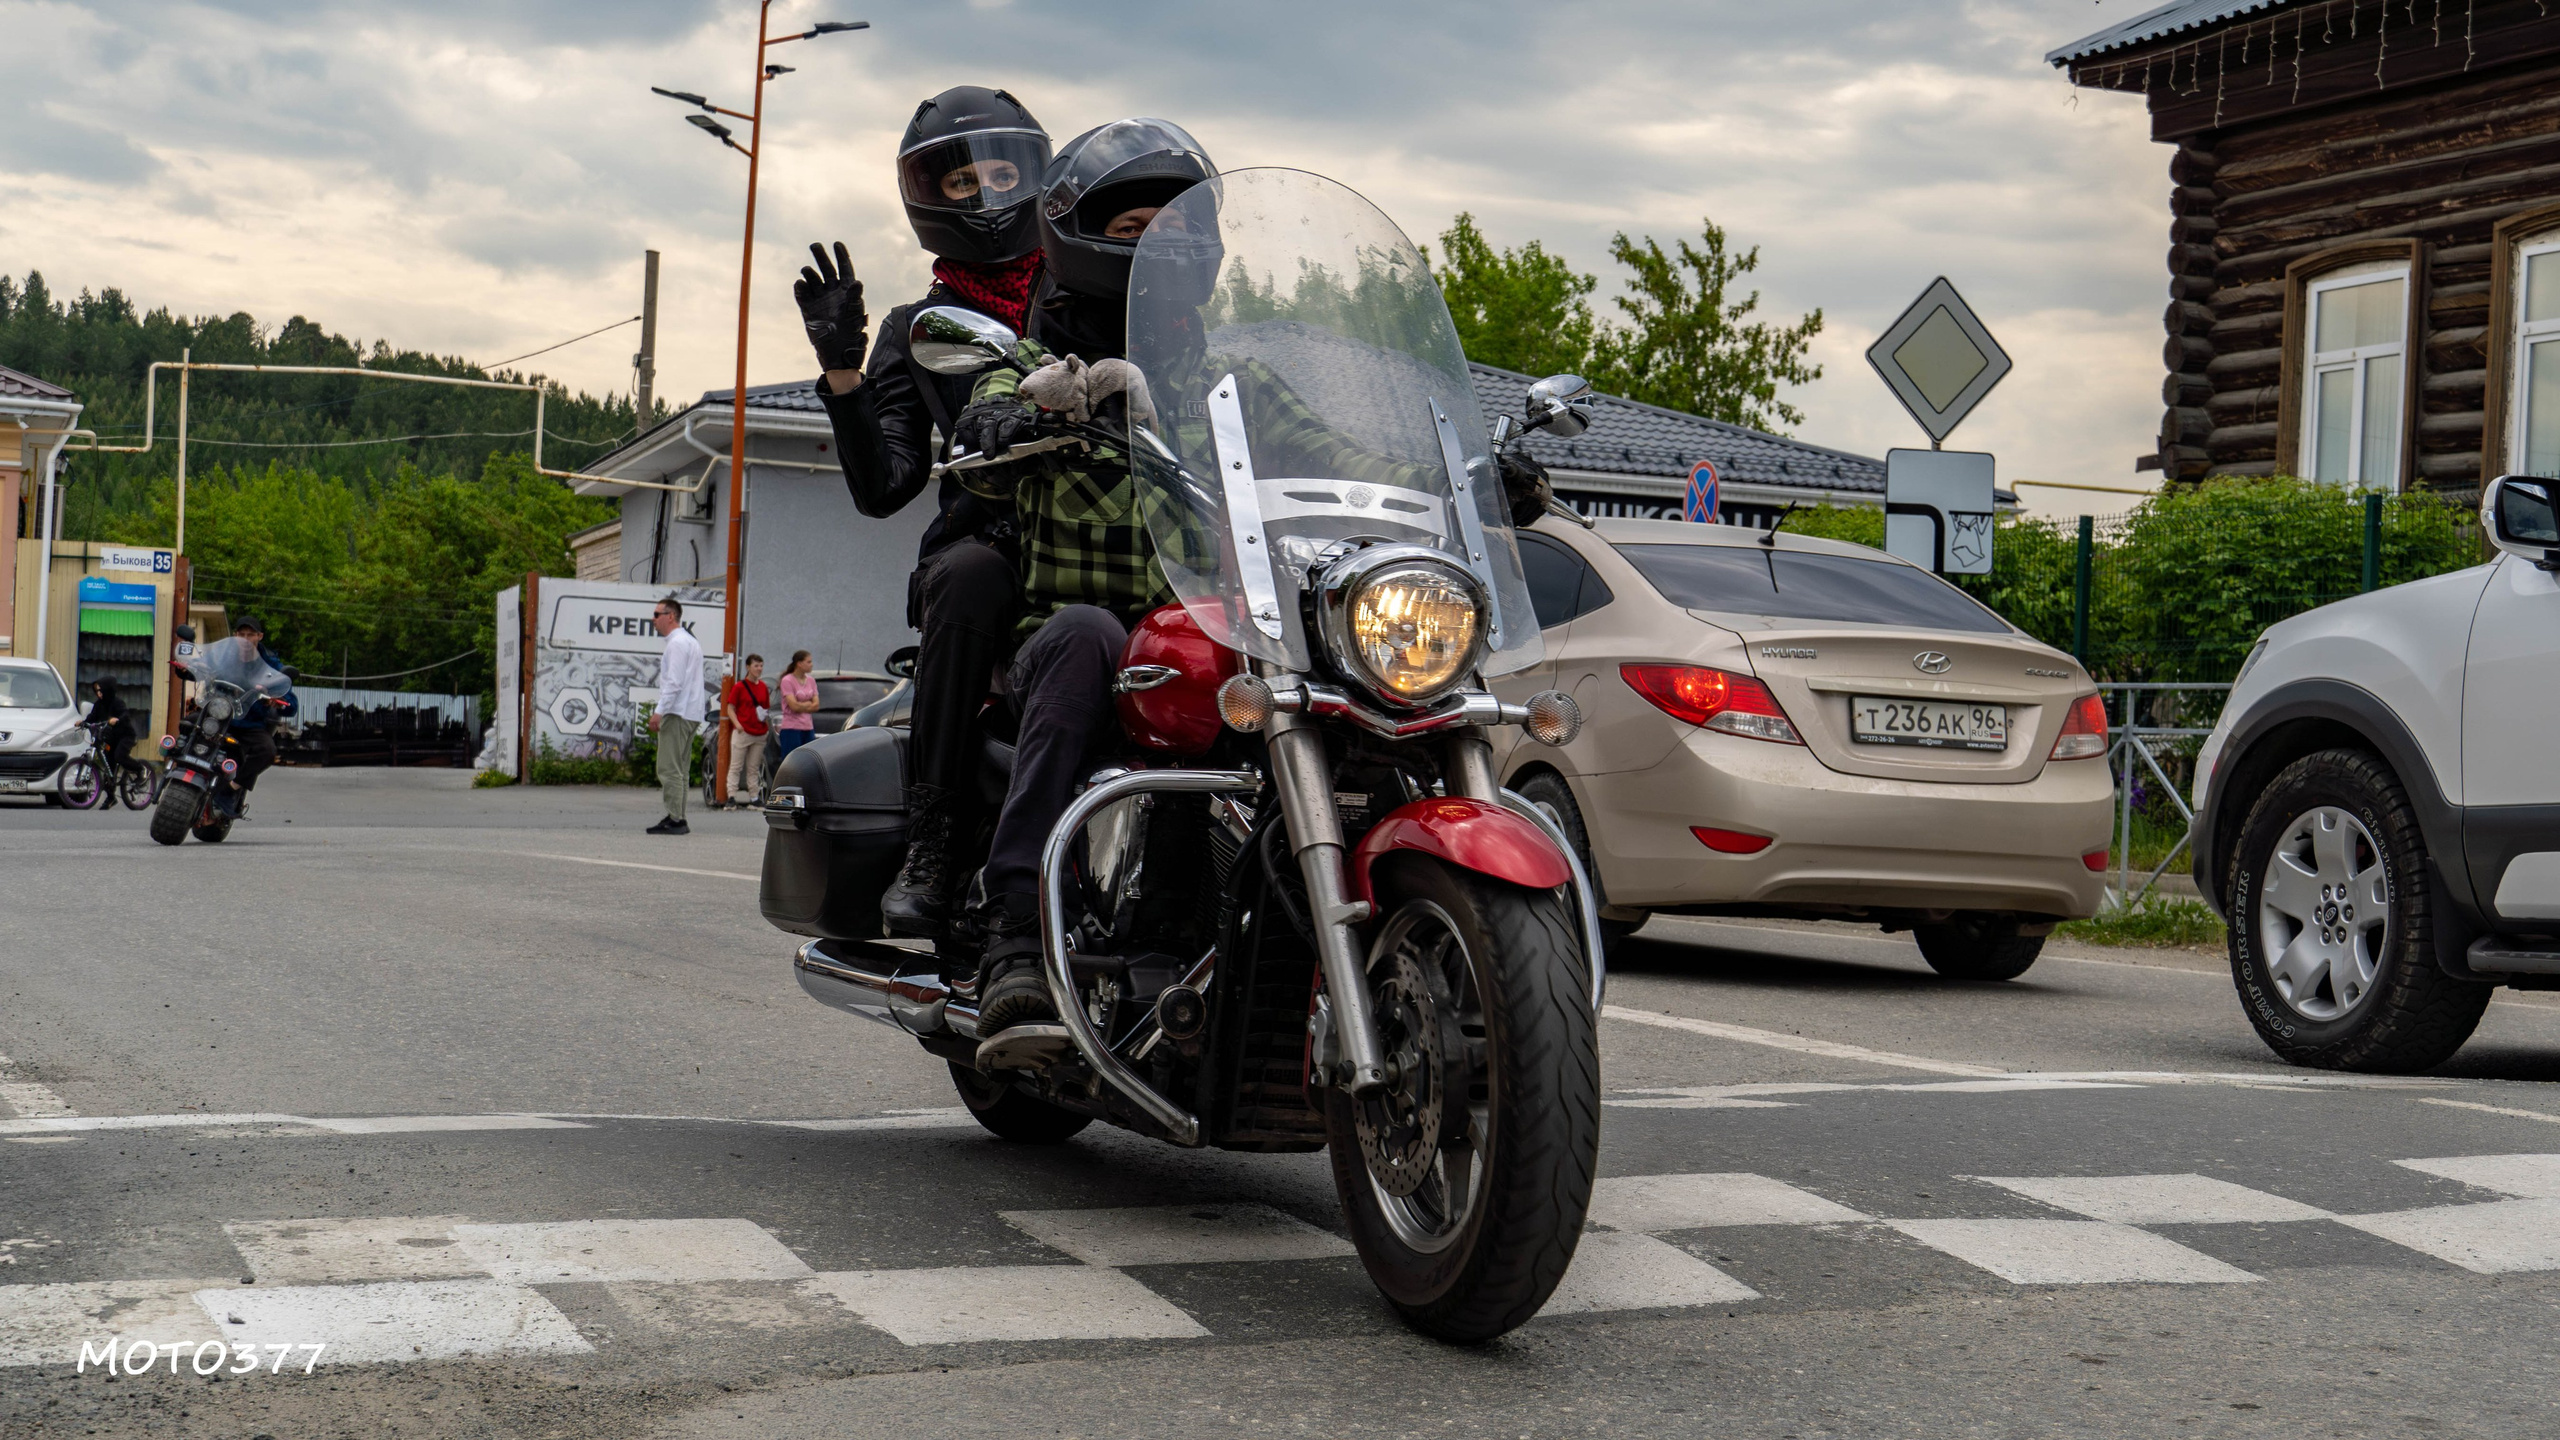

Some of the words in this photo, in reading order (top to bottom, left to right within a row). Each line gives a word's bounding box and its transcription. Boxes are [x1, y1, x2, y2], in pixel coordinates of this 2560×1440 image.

[112, 553, 152, 567] Быкова
[155, 554, 171, 570] 35
[588, 614, 698, 640] КРЕП
[1762, 646, 1818, 659] HYUNDAI
[2025, 667, 2069, 679] SOLARIS
[1972, 708, 1997, 730] 96
[1971, 729, 1990, 738] RUS
[11, 780, 25, 788] 196
[2235, 870, 2296, 1039] COMFORSER
